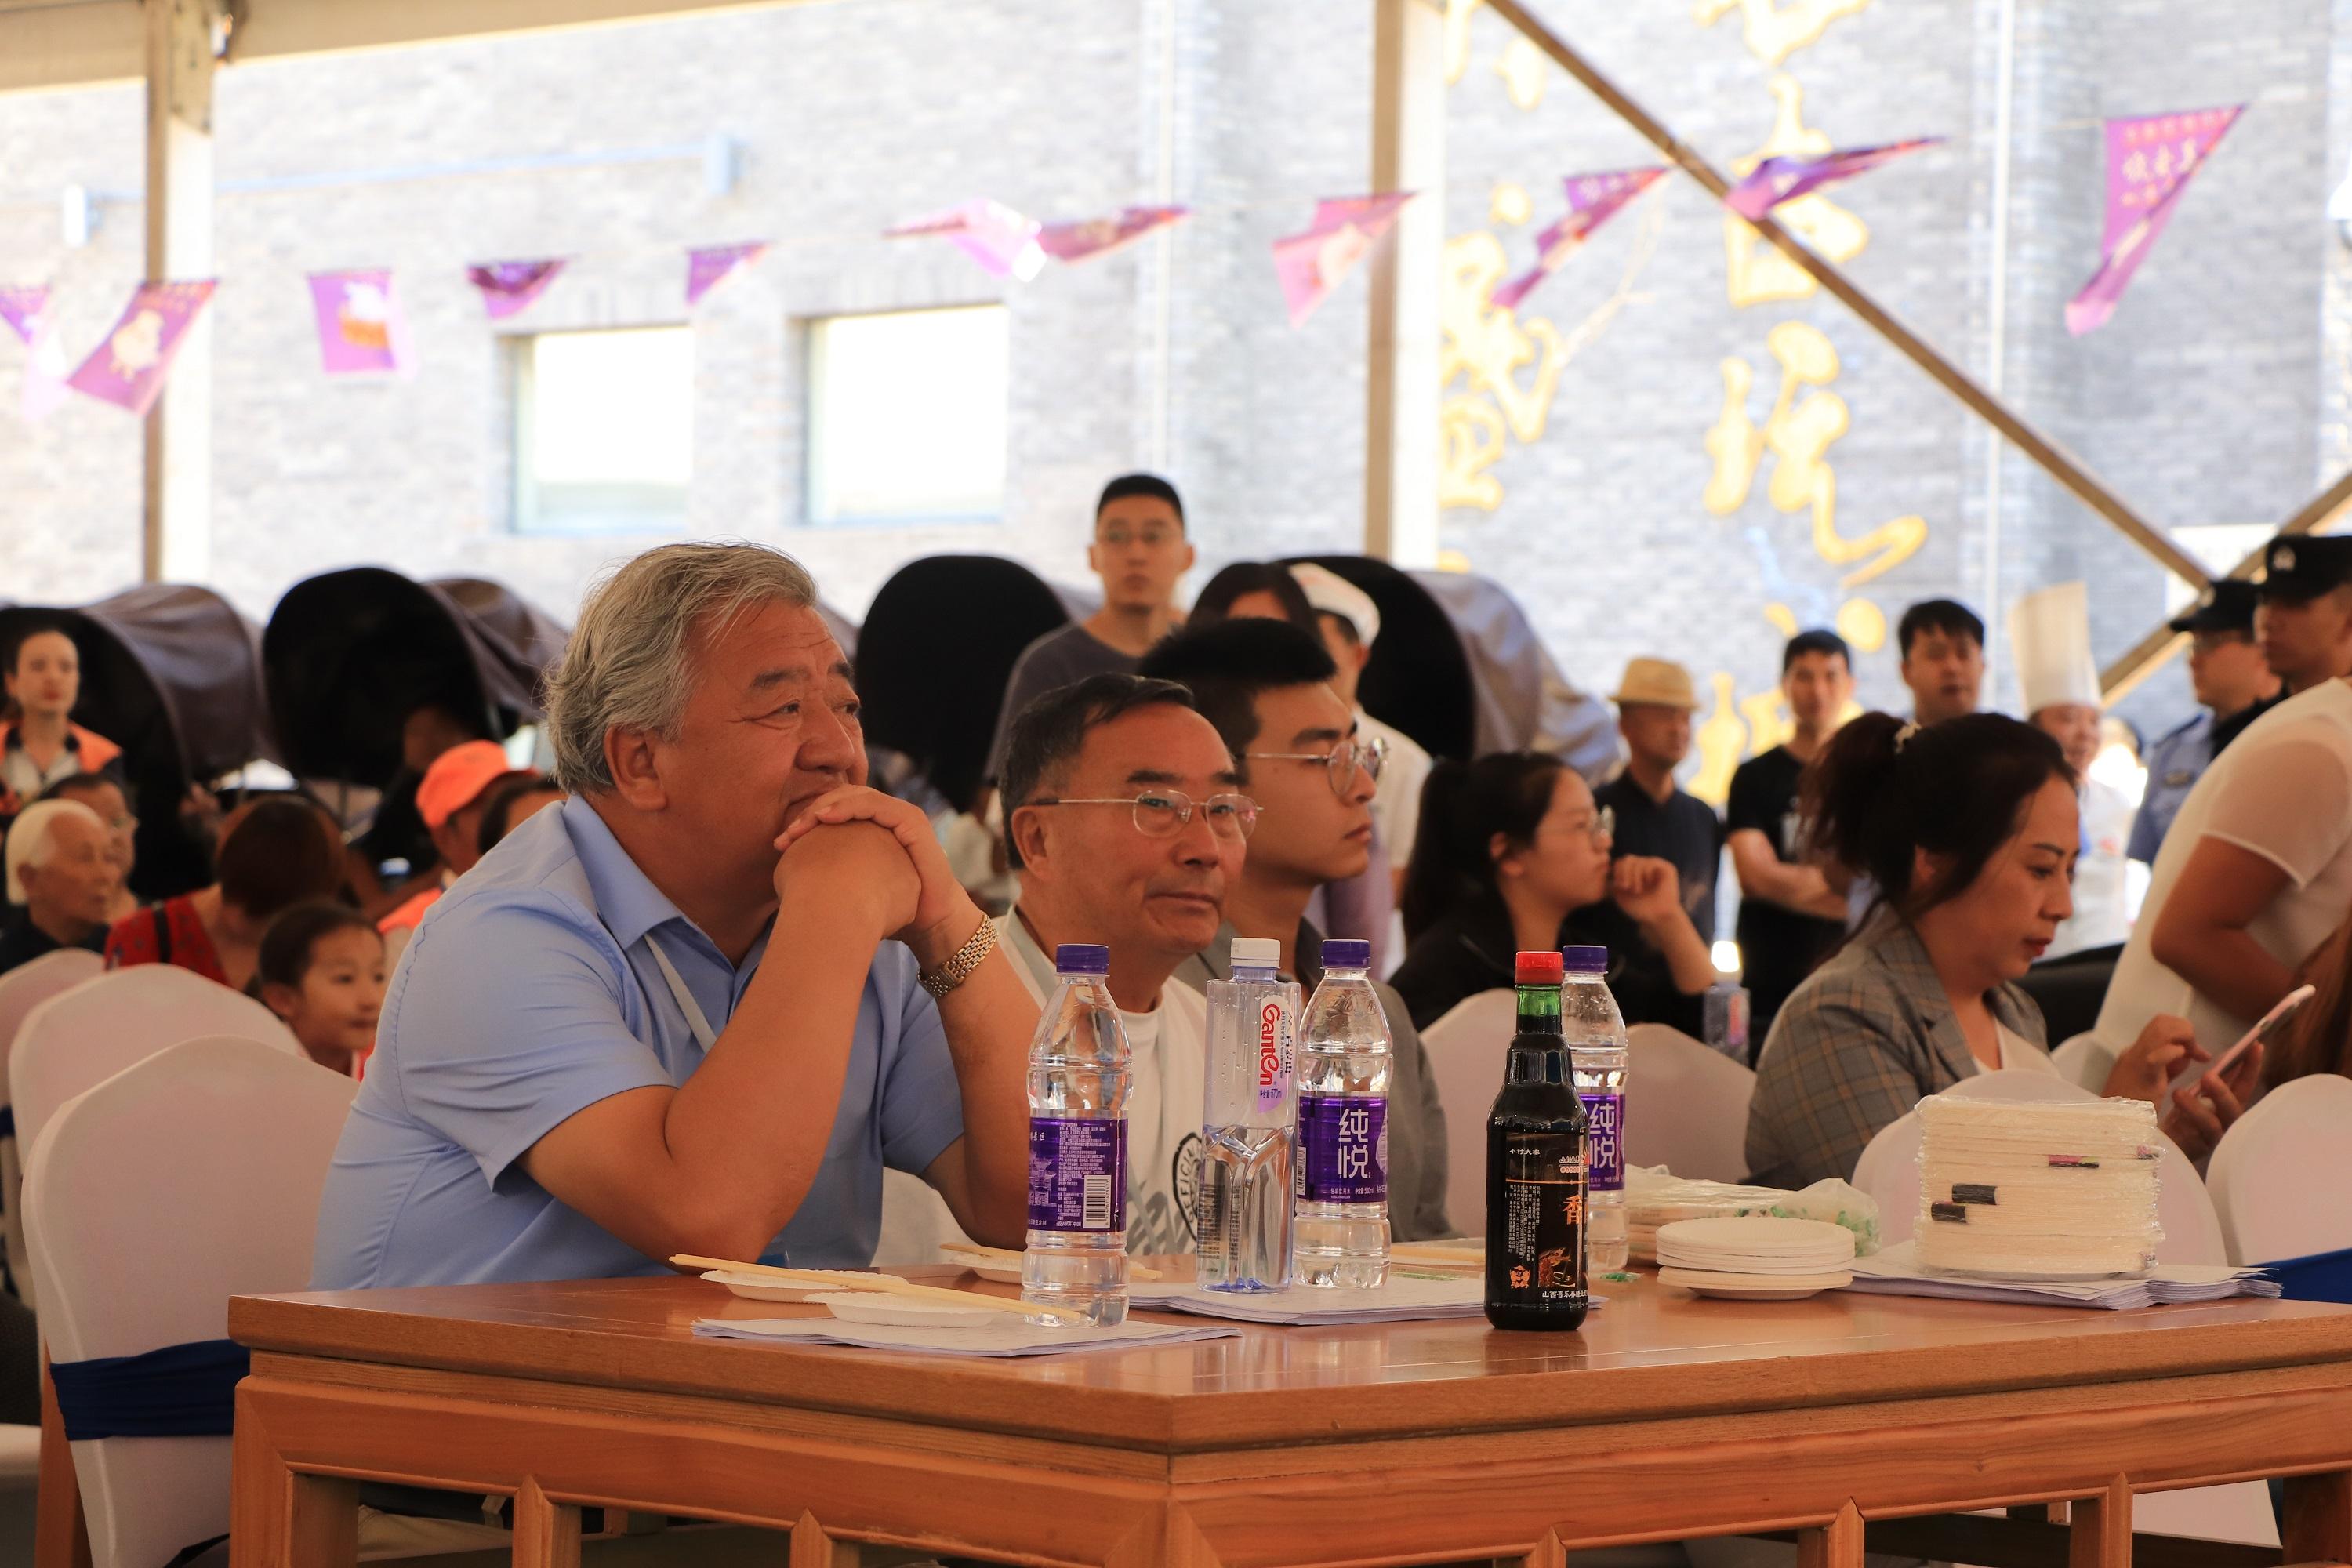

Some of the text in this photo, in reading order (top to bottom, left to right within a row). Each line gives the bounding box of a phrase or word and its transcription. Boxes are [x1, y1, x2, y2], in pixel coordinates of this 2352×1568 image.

[1338, 1108, 1369, 1179] 纯悦
[1589, 1102, 1615, 1169] 纯悦
[1563, 1194, 1588, 1225] 香
